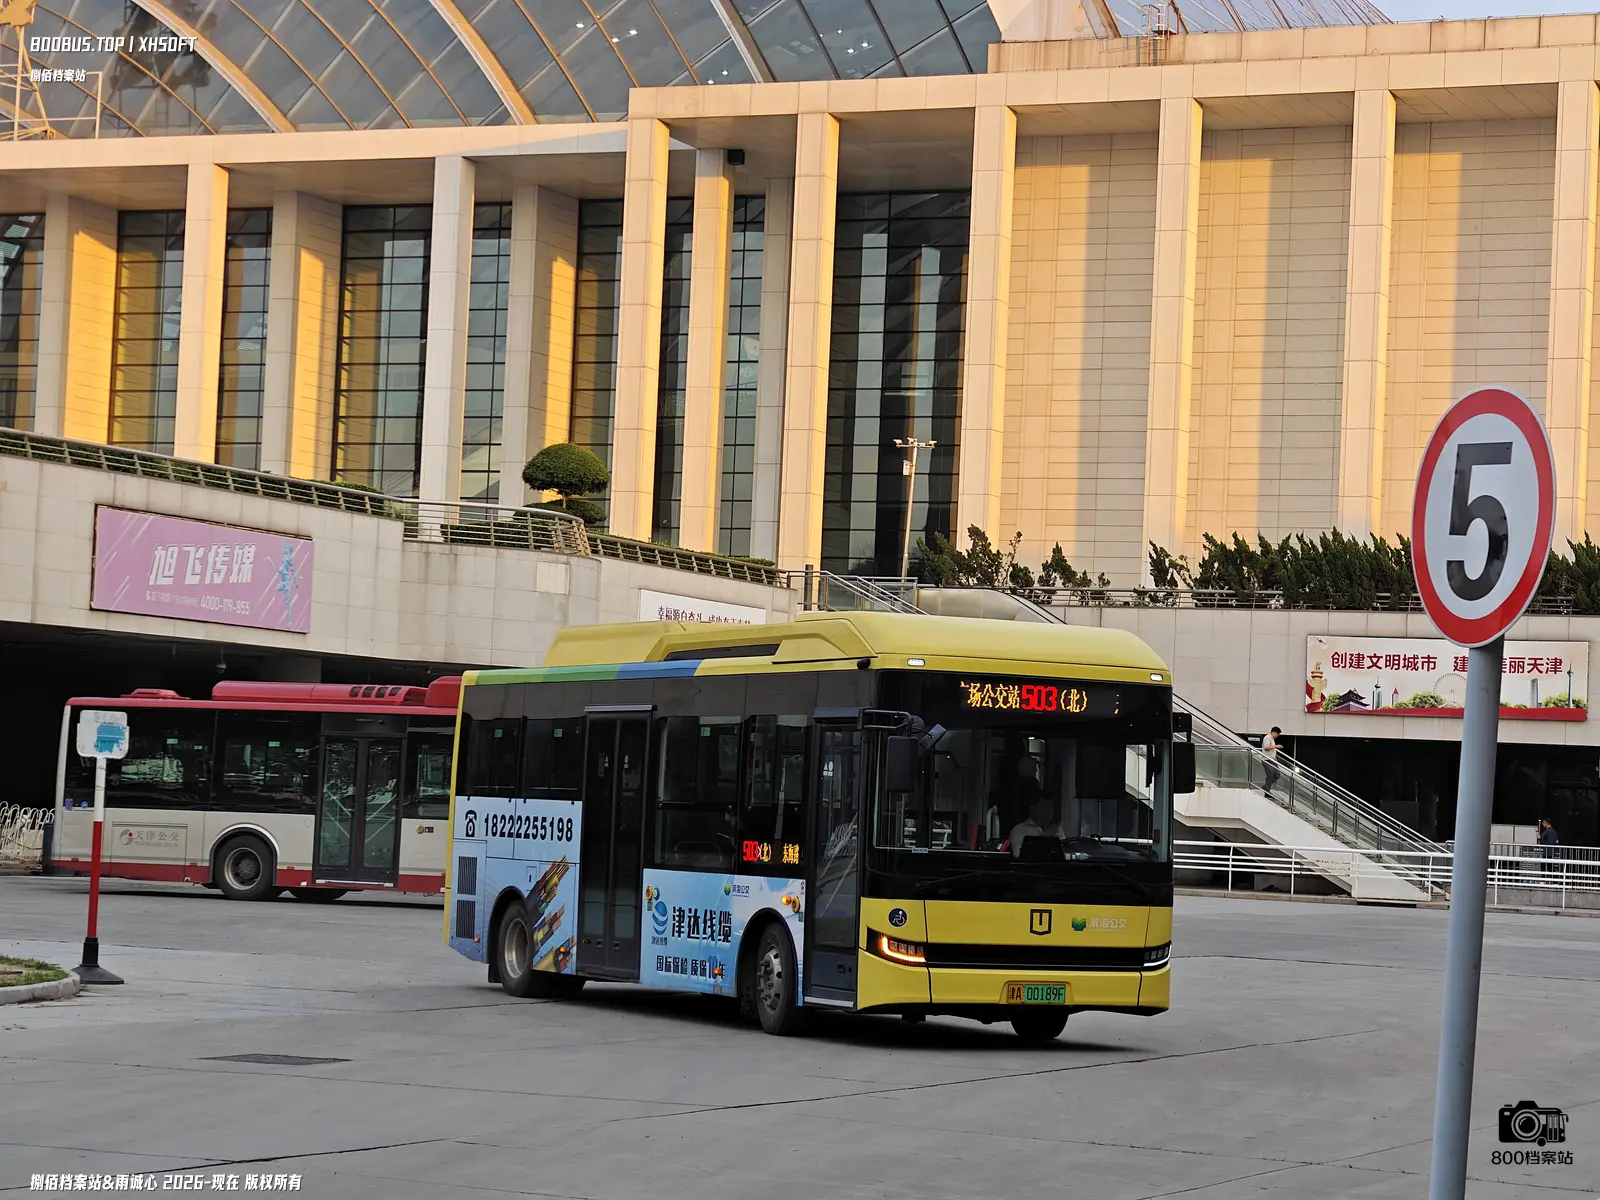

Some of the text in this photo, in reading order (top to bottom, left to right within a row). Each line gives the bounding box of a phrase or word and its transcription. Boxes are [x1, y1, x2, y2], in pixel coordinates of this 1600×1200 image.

[1446, 441, 1513, 601] 5
[149, 544, 256, 585] 旭飞传媒
[1331, 651, 1437, 672] 创建文明城市
[484, 813, 574, 842] 18222255198
[671, 906, 733, 943] 津达线缆
